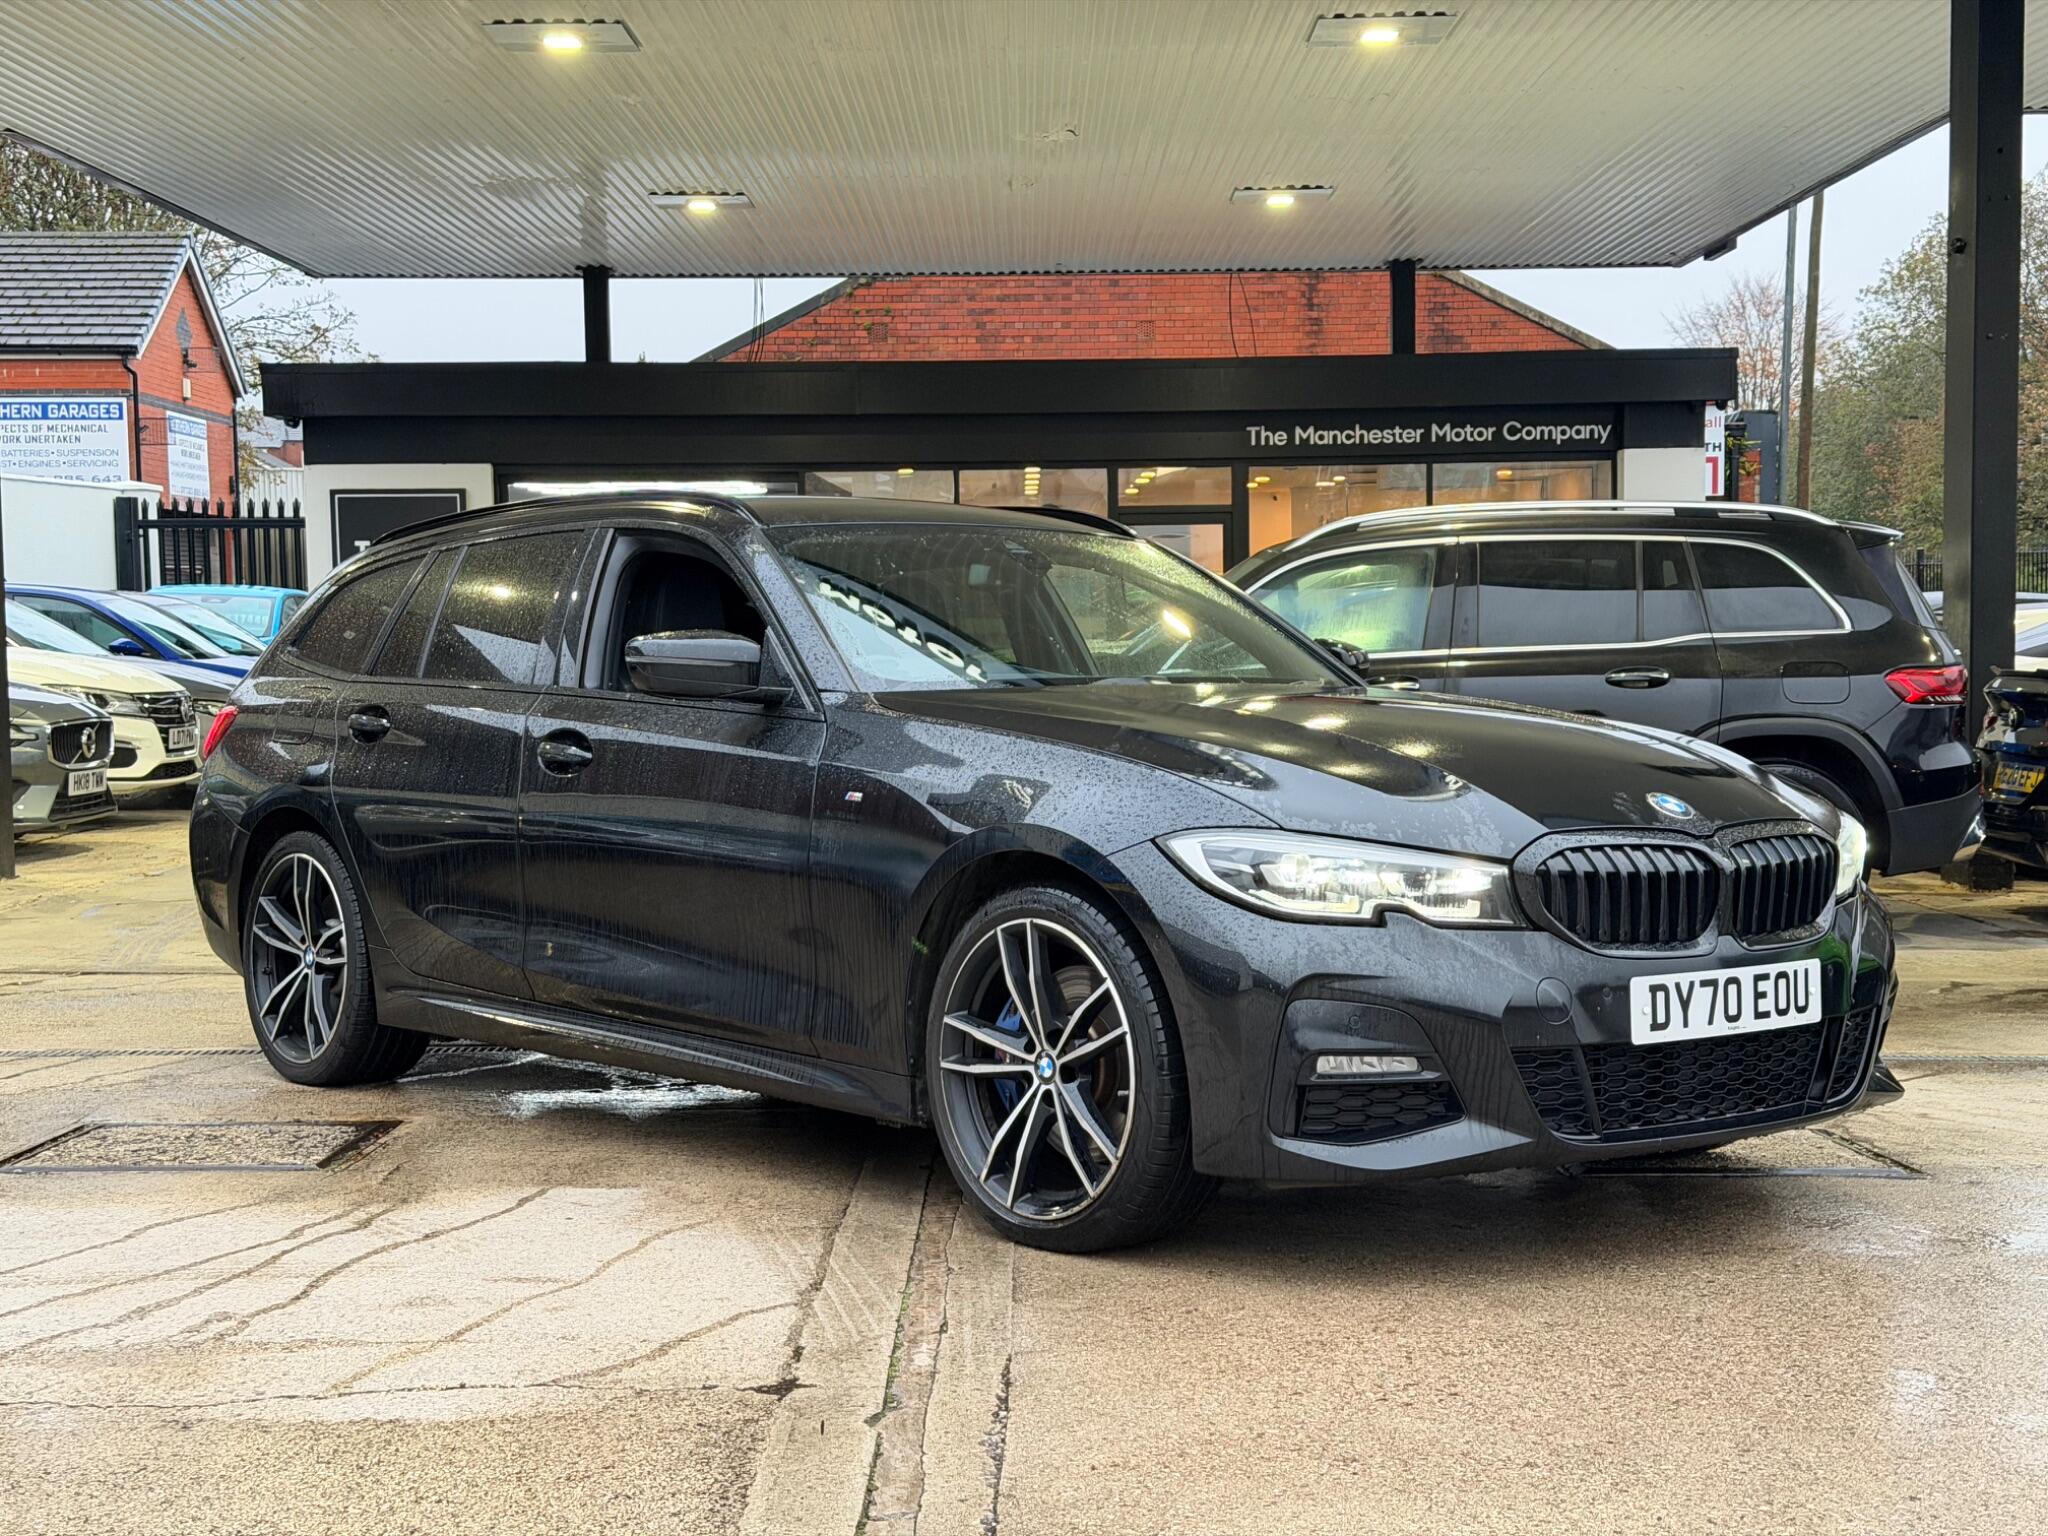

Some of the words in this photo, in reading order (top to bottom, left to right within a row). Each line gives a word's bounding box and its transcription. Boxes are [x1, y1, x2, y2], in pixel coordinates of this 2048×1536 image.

[0, 404, 42, 418] HERN
[47, 404, 120, 418] GARAGES
[32, 424, 44, 433] OF
[47, 424, 109, 433] MECHANICAL
[1246, 426, 1287, 446] The
[1295, 424, 1425, 446] Manchester
[1431, 423, 1496, 443] Motor
[1503, 421, 1612, 445] Company
[0, 435, 22, 444] ORK
[1, 449, 50, 457] BATTERIES
[56, 448, 119, 456] SUSPENSION
[67, 459, 119, 467] SERVICING
[1648, 976, 1742, 1032] DY70
[1753, 967, 1809, 1020] EOU
